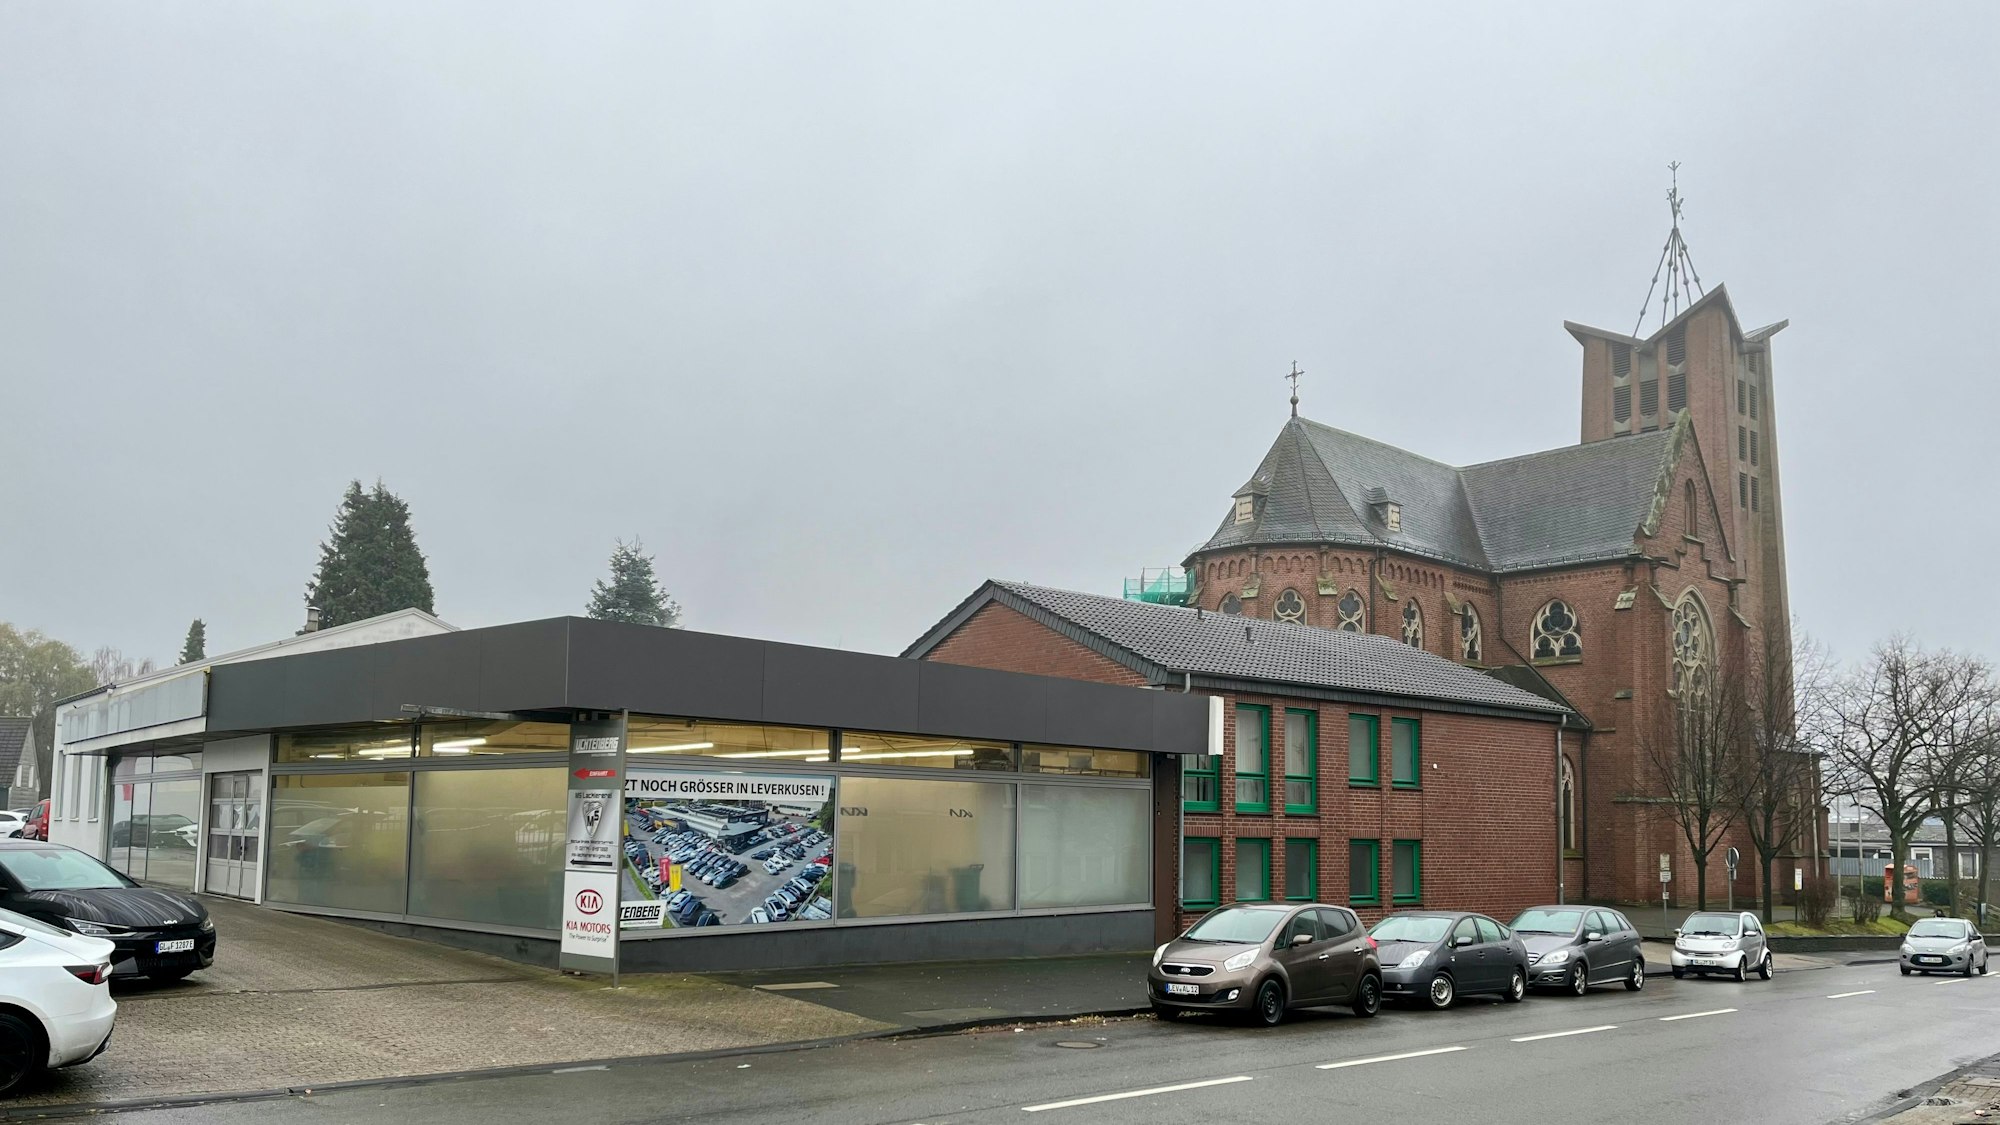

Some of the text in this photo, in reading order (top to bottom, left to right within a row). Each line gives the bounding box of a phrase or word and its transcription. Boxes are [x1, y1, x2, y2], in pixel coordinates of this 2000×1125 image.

[640, 779, 677, 793] NOCH
[680, 779, 734, 794] GRÖSSER
[736, 782, 748, 794] IN
[751, 783, 819, 796] LEVERKUSEN
[580, 895, 599, 909] KIA
[566, 920, 578, 931] KIA
[580, 922, 611, 935] MOTORS
